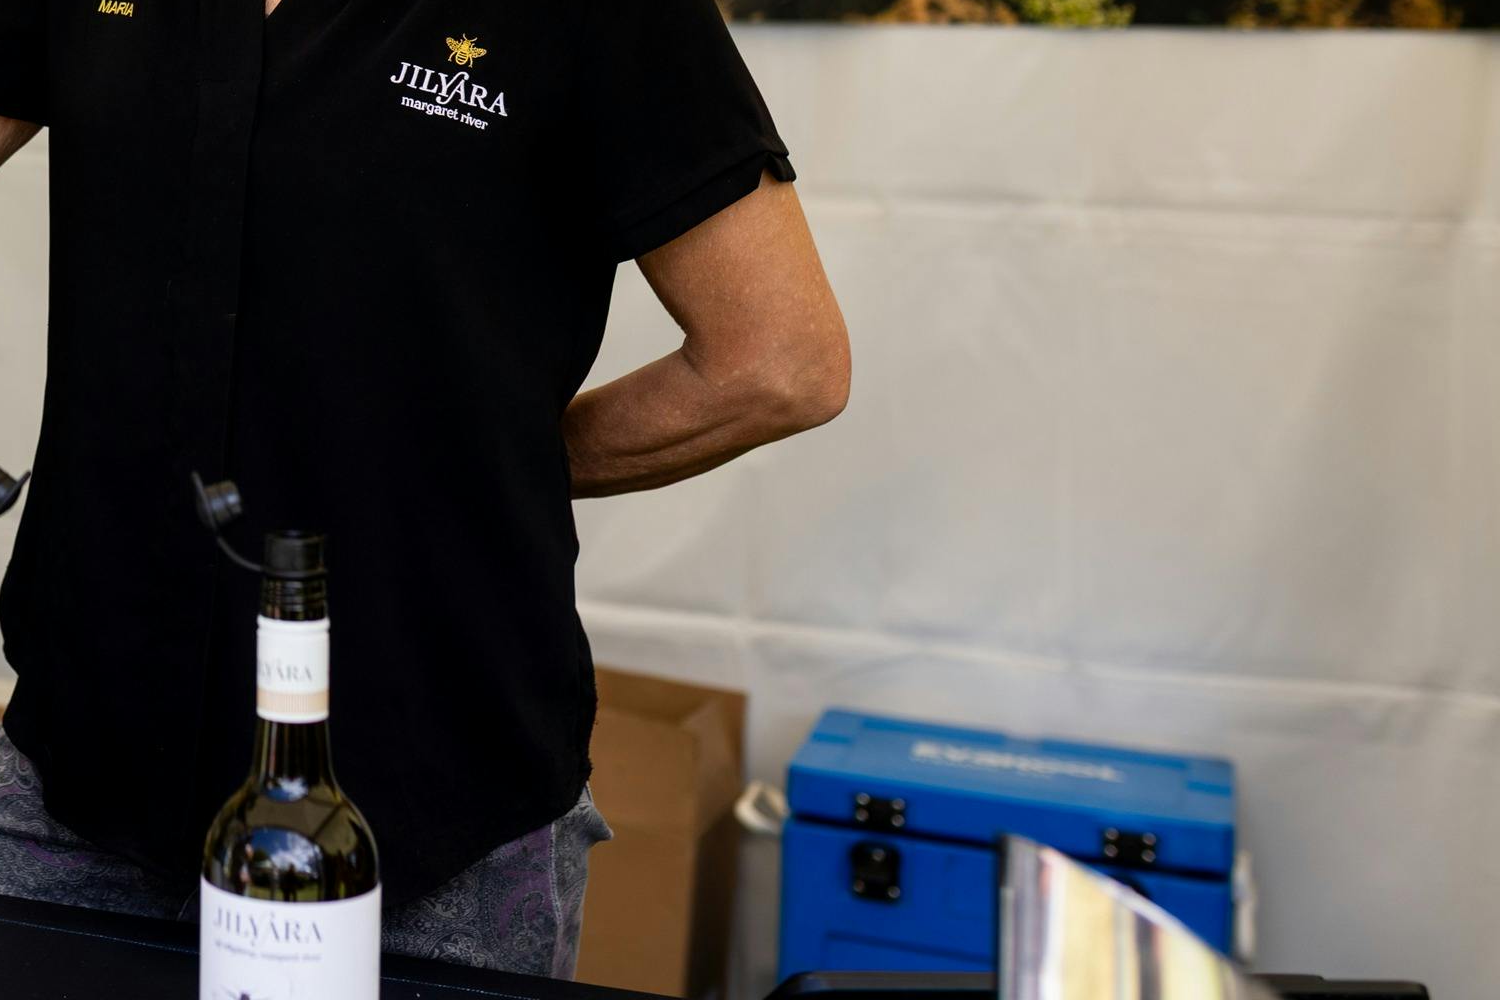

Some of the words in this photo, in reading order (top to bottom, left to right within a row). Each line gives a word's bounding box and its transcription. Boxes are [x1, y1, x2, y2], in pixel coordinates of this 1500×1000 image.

[390, 61, 508, 117] JILYARA
[401, 96, 459, 121] margaret
[460, 112, 489, 130] river
